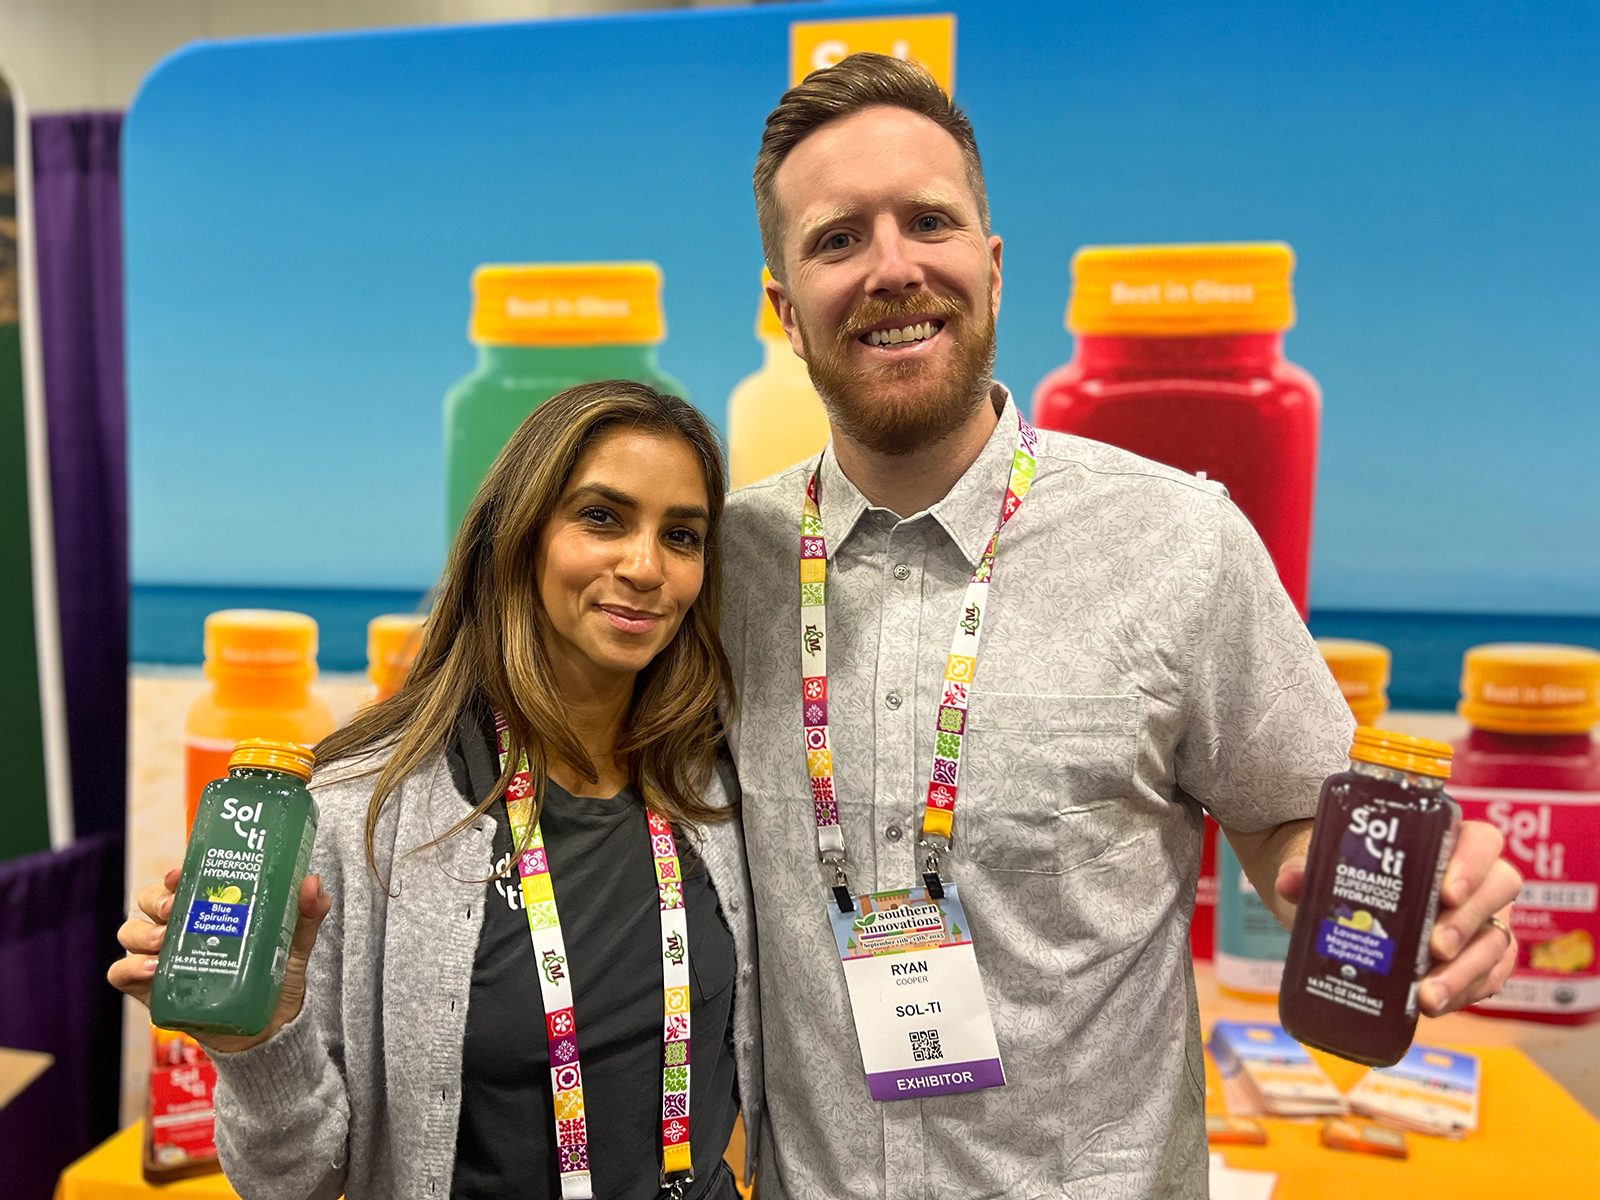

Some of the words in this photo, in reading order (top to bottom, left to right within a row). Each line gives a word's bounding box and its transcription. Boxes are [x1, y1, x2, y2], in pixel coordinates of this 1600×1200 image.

[960, 603, 980, 636] L&M
[803, 624, 823, 655] L&M
[220, 797, 263, 822] Sol
[1348, 807, 1399, 843] Sol
[247, 827, 267, 850] ti
[207, 848, 264, 863] ORGANIC
[1381, 847, 1405, 876] ti
[203, 868, 259, 881] HYDRATION
[205, 859, 260, 872] SUPERFOOD
[1336, 864, 1403, 891] ORGANIC
[1334, 875, 1400, 901] SUPERFOOD
[212, 903, 231, 913] Blue
[1332, 886, 1397, 912] HYDRATION
[199, 912, 239, 924] Spirulina
[878, 905, 937, 921] southern
[194, 921, 237, 932] SuperAde
[865, 916, 940, 934] innovations
[864, 940, 895, 948] September
[1333, 926, 1380, 947] Lavender
[665, 932, 685, 966] L&M
[1326, 934, 1384, 960] Magnesium
[1327, 944, 1376, 966] SuperAde
[210, 958, 228, 967] (440
[542, 949, 565, 984] L&M
[891, 960, 928, 976] RYAN
[896, 976, 928, 986] COOPER
[1324, 982, 1333, 992] FL
[1334, 985, 1347, 996] OZ
[896, 1001, 942, 1018] SOL-TI
[896, 1071, 974, 1090] EXHIBITOR
